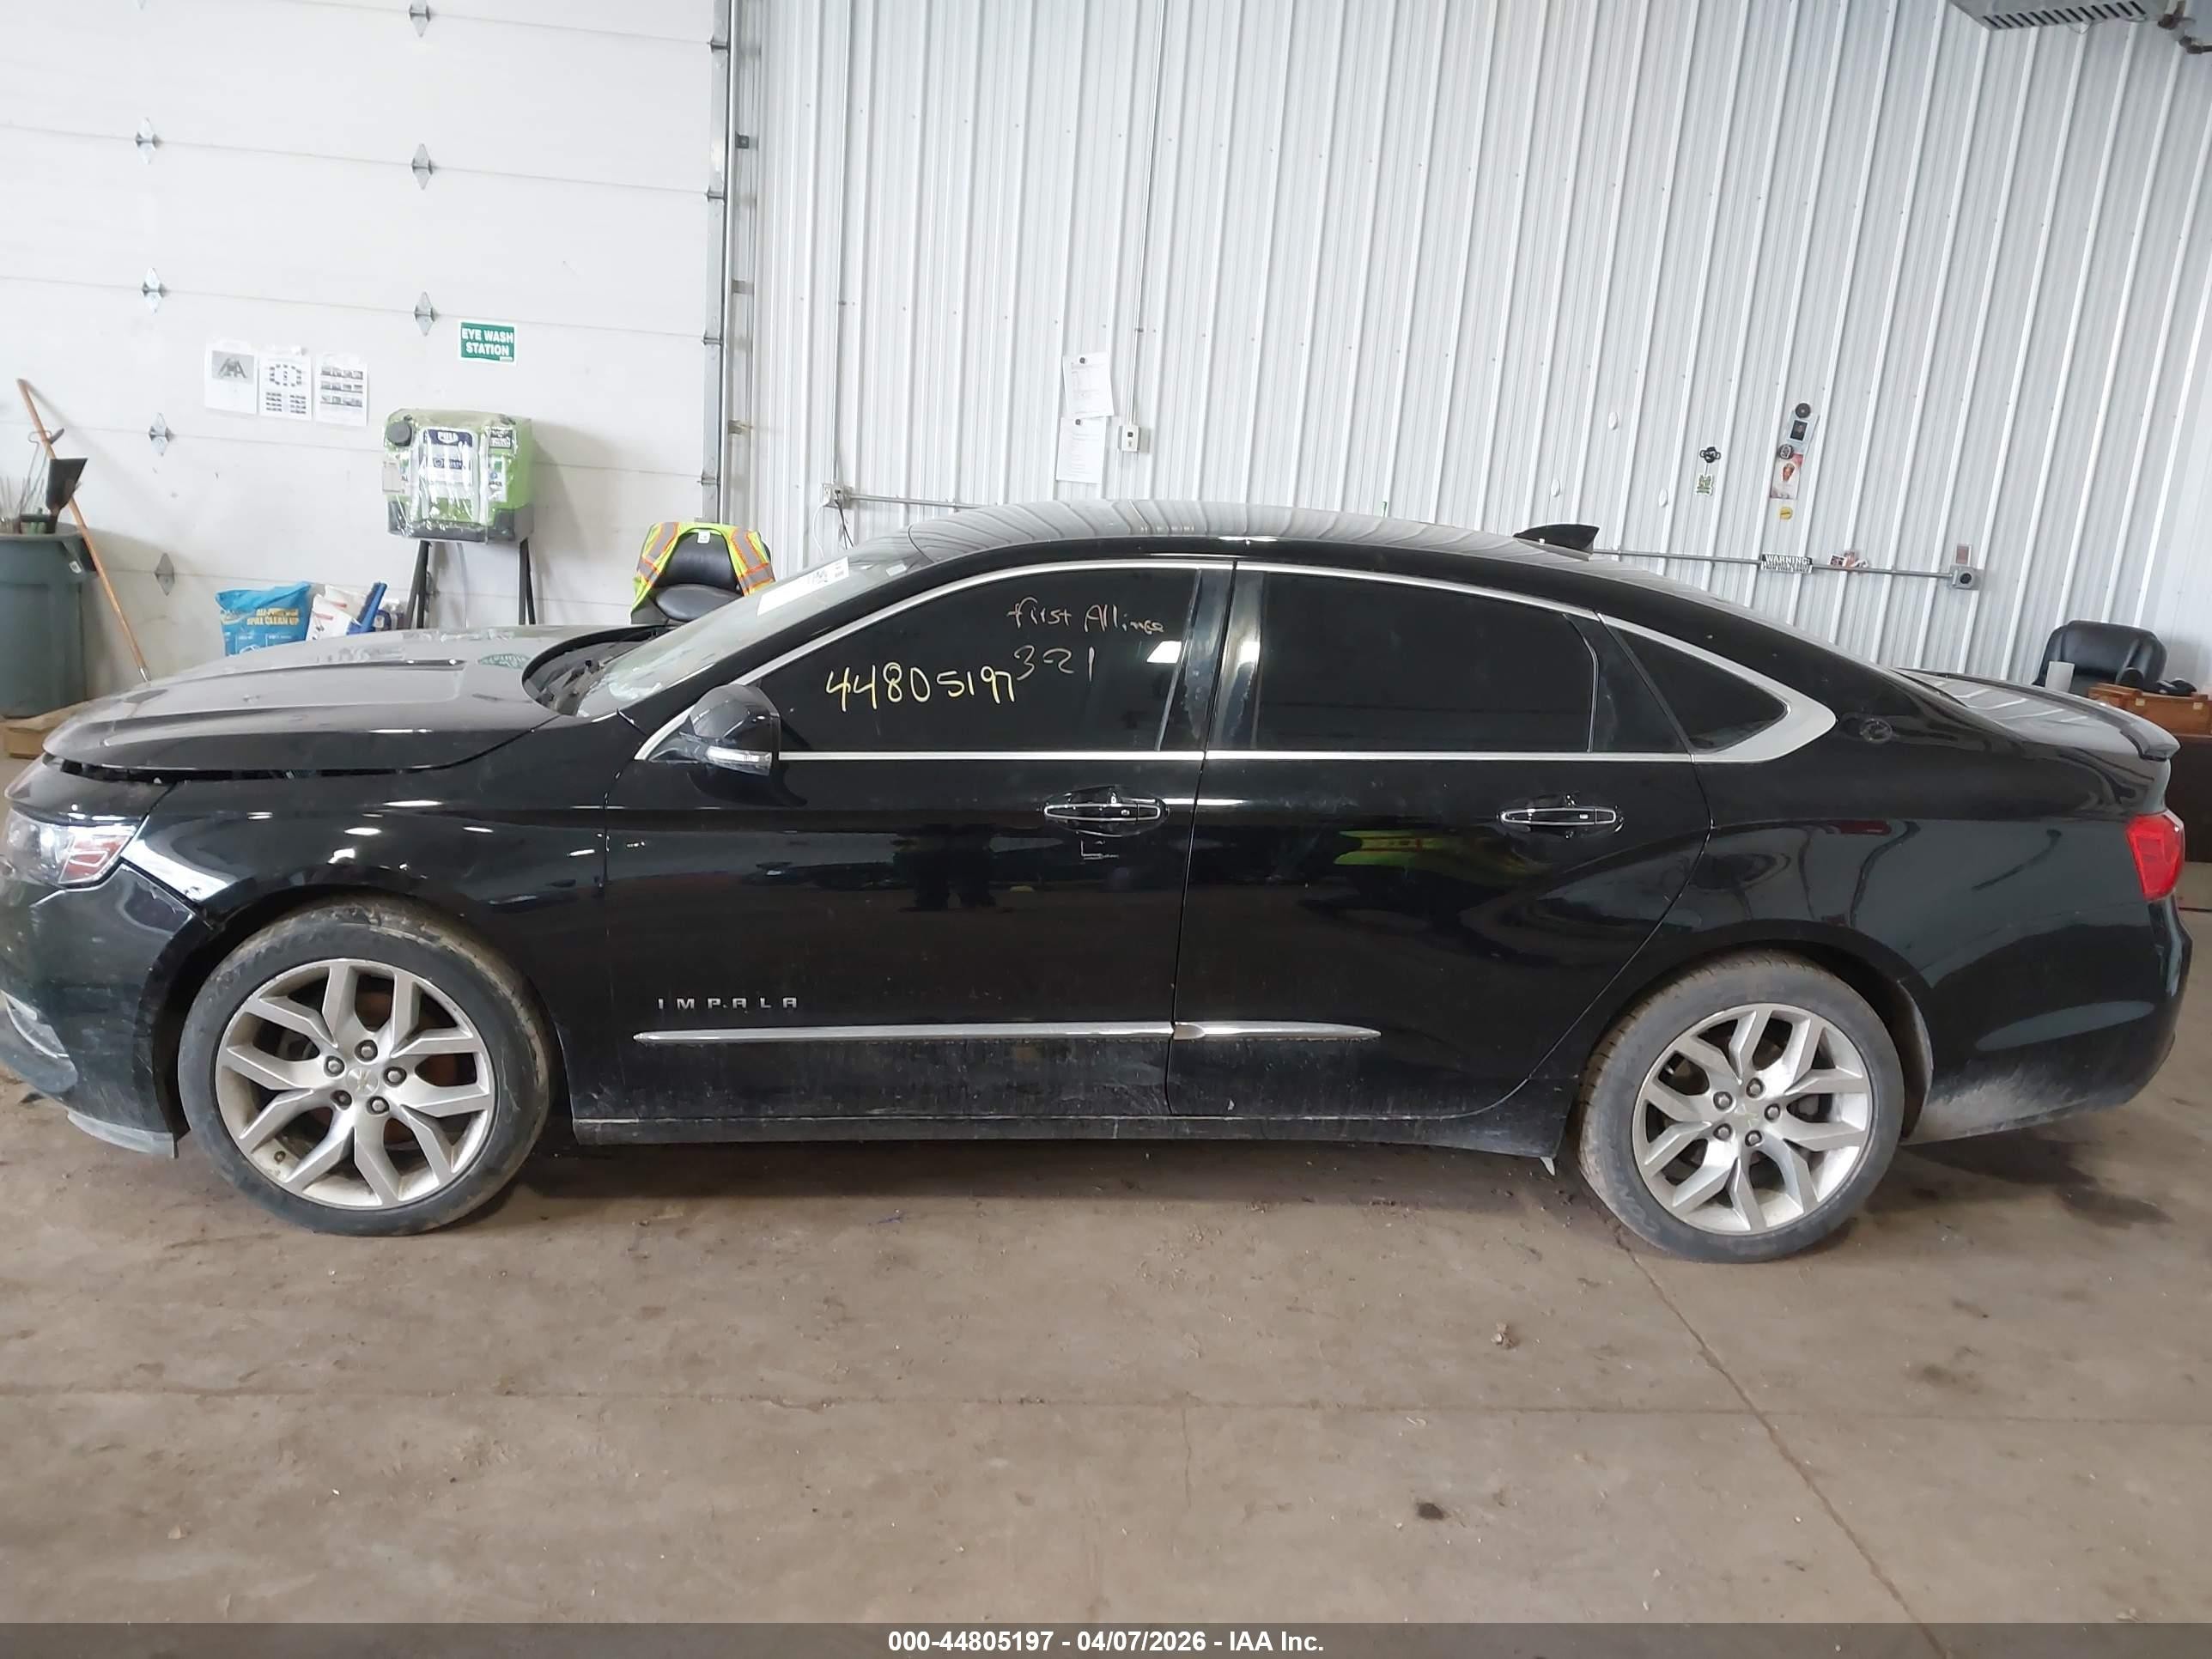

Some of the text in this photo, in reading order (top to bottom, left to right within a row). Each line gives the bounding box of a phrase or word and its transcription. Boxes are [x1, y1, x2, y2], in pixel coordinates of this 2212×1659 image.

[462, 327, 514, 344] EYE WASH
[465, 341, 510, 356] STATION
[825, 660, 1017, 713] 44805197
[658, 997, 798, 1010] IMPALA
